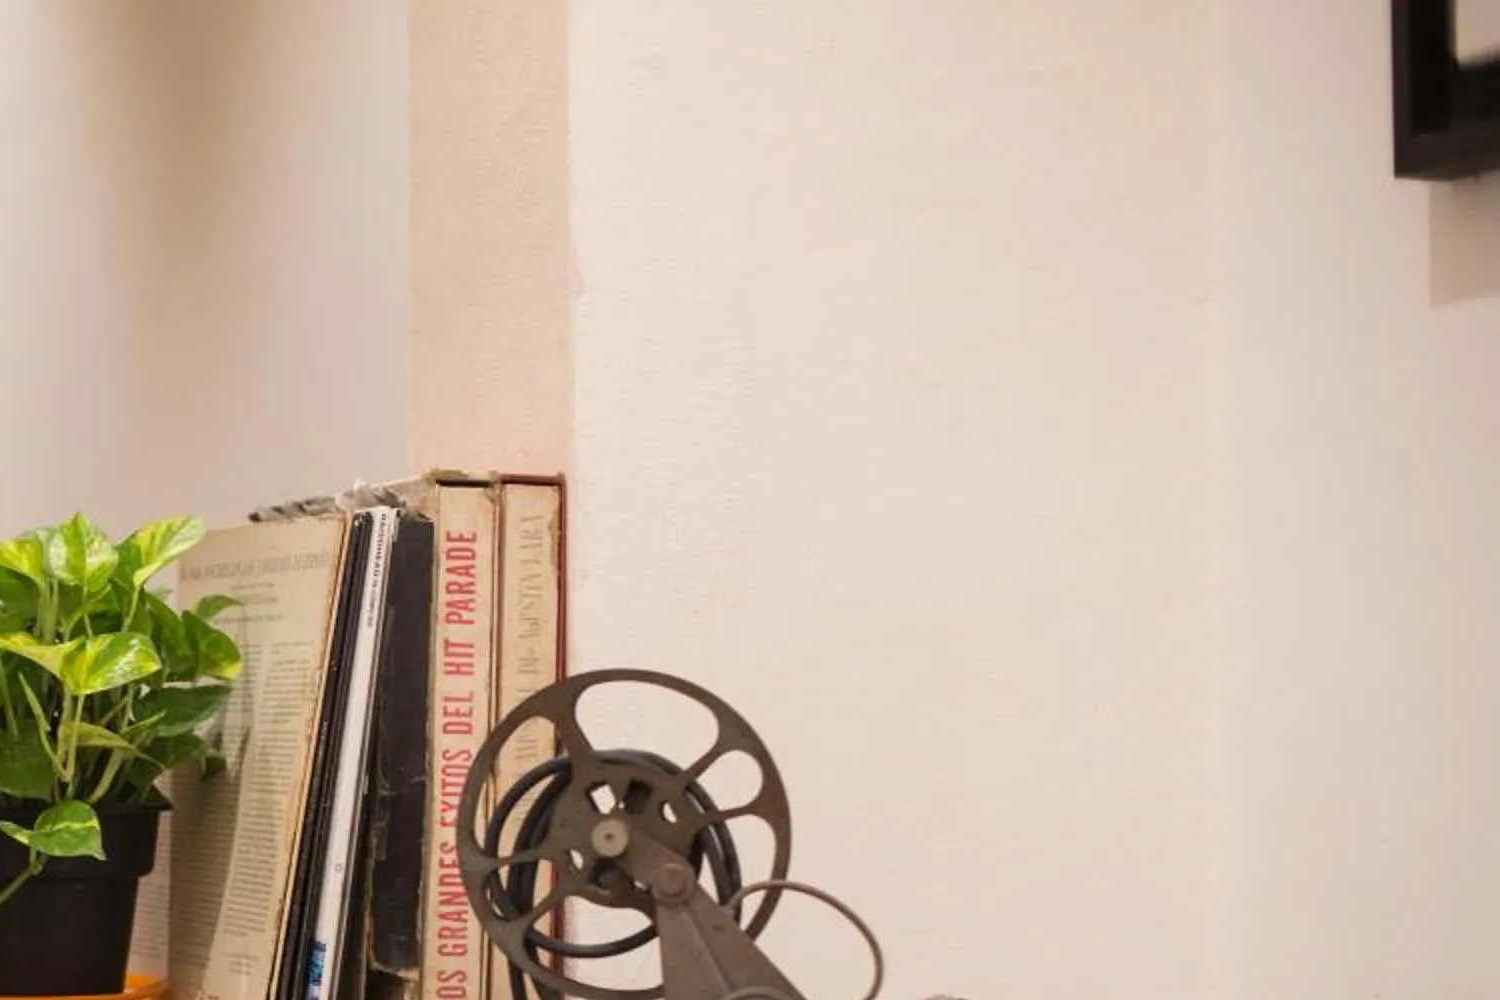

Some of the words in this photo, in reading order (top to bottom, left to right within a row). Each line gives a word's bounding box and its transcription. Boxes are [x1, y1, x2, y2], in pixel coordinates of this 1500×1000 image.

[445, 531, 478, 625] PARADE
[442, 638, 476, 677] HIT
[441, 690, 473, 735] DEL
[437, 841, 470, 957] GRANDES
